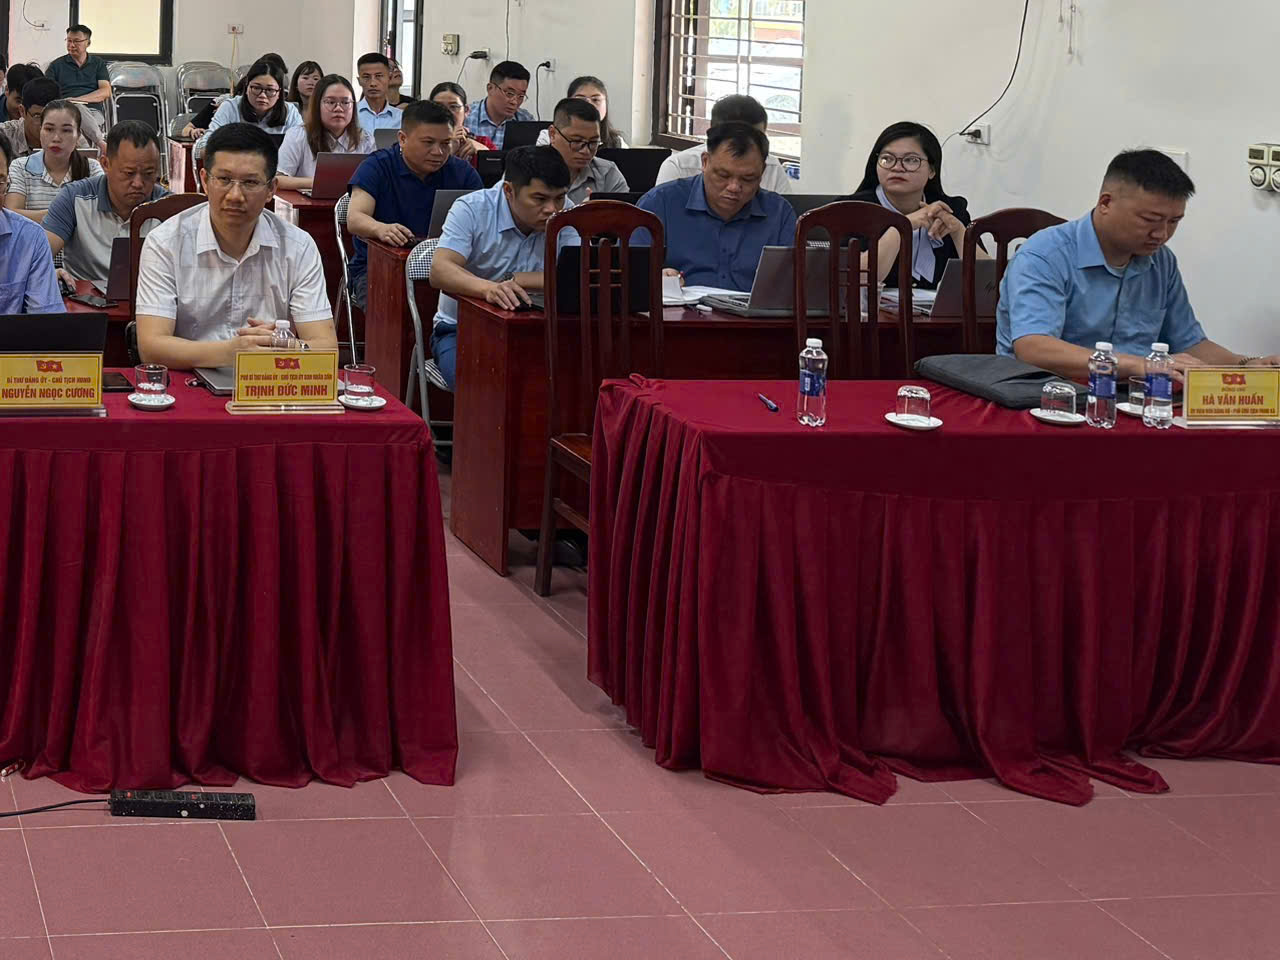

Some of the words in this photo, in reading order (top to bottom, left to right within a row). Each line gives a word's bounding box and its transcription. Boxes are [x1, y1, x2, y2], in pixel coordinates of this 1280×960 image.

[1, 385, 37, 399] NGUYỄN
[39, 388, 63, 400] NGỌC
[65, 387, 95, 398] CƯƠNG
[245, 385, 274, 399] TRỊNH
[277, 382, 298, 396] ĐỨC
[301, 384, 328, 396] MINH
[1202, 392, 1215, 405] HÀ
[1217, 393, 1236, 405] VĂN
